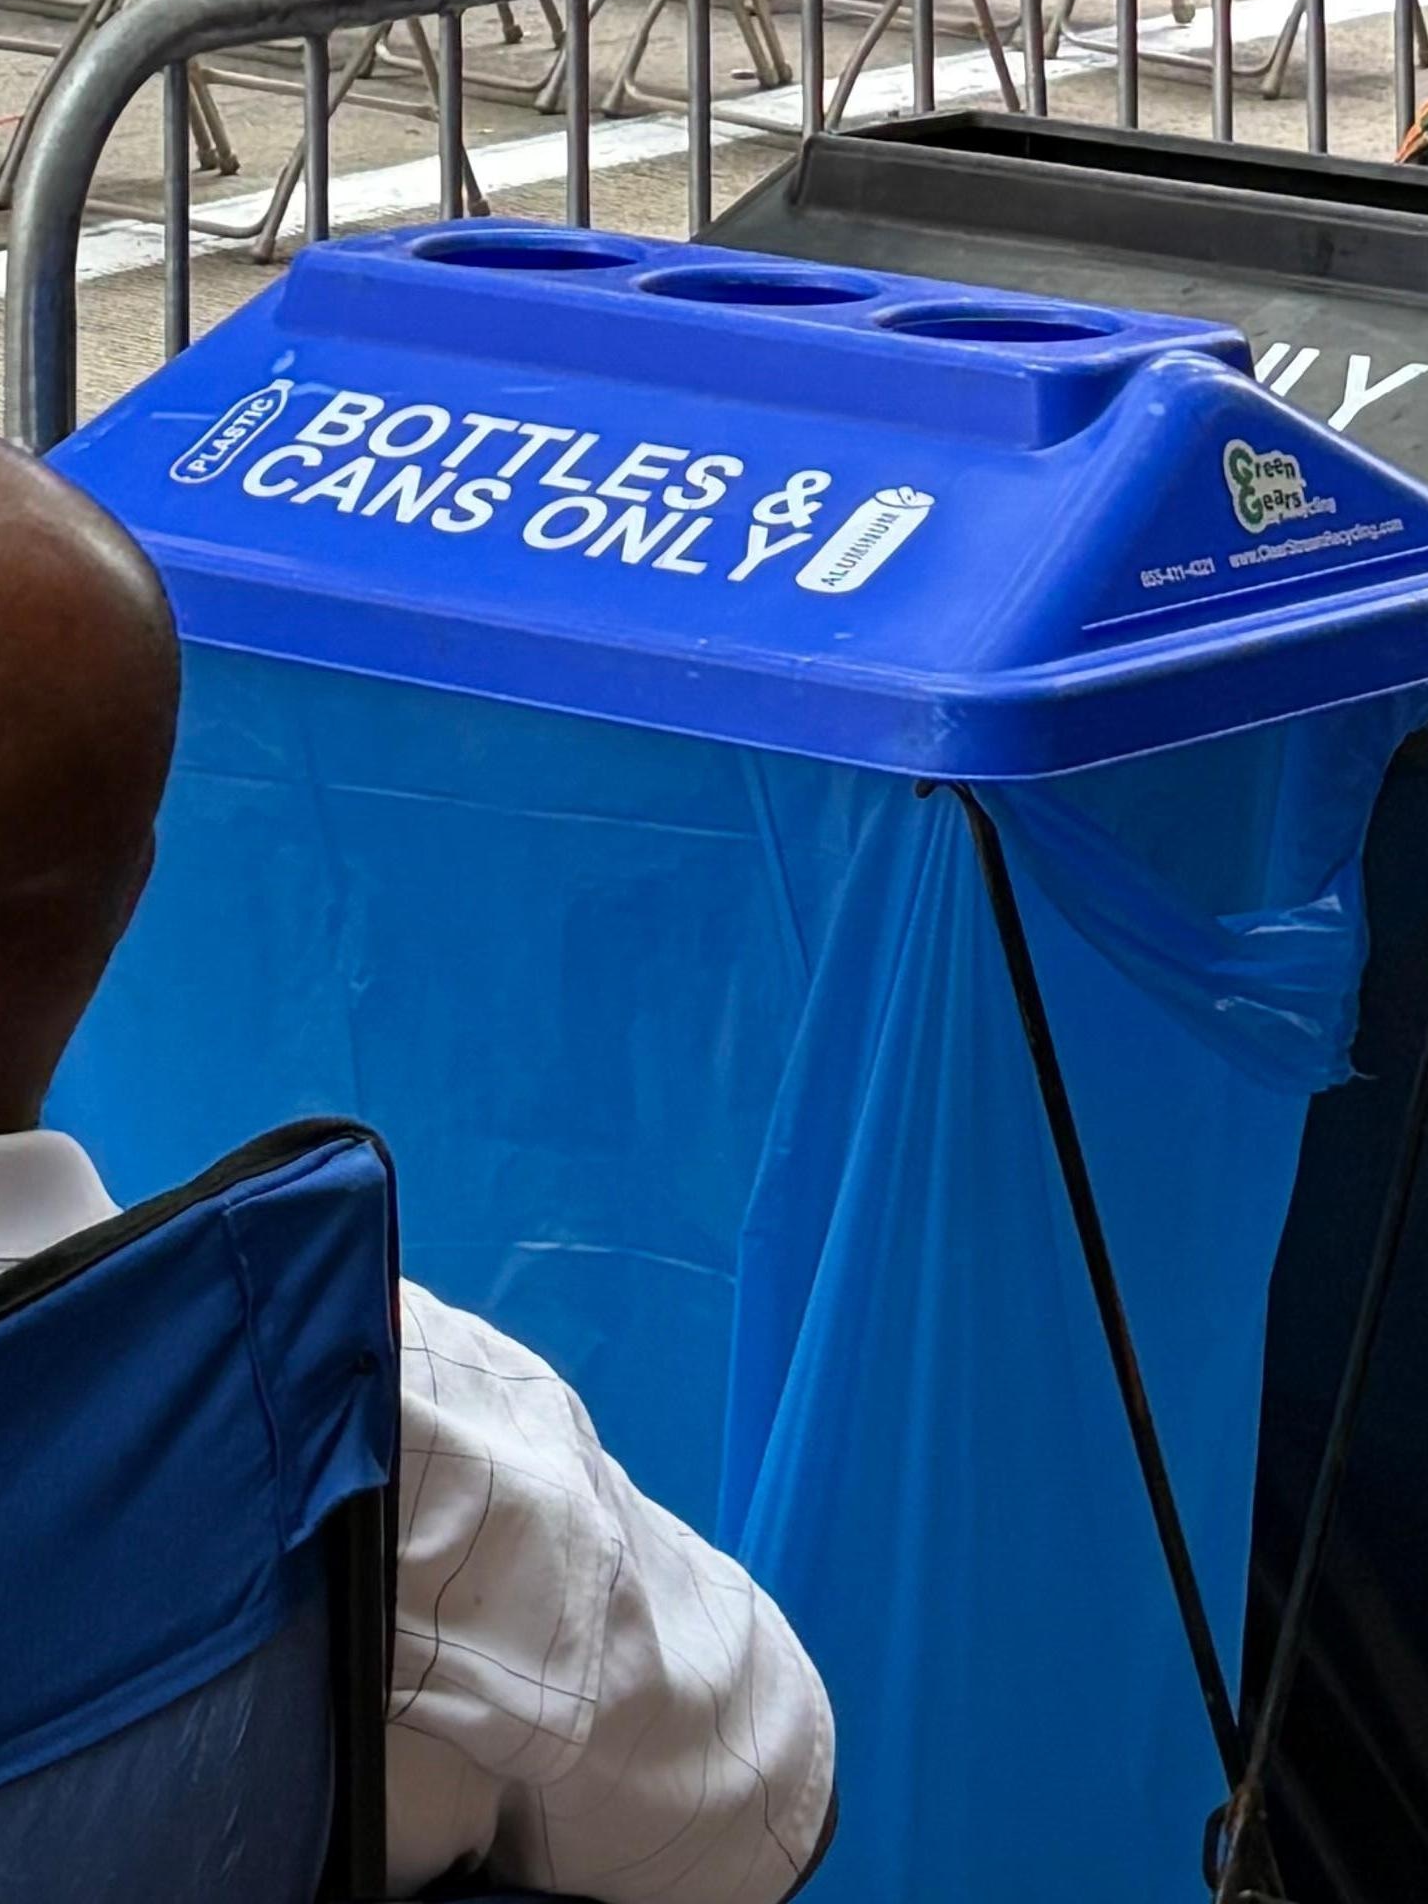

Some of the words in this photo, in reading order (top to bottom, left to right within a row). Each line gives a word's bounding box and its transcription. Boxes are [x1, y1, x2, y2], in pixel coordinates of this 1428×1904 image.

[187, 398, 274, 473] PLASTIC
[295, 390, 744, 510] BOTTLES
[753, 470, 832, 528] &
[1229, 448, 1296, 486] Green
[243, 445, 512, 533] CANS
[523, 496, 813, 582] ONLY
[1239, 486, 1302, 524] Gears
[821, 510, 900, 587] ALUMINUM
